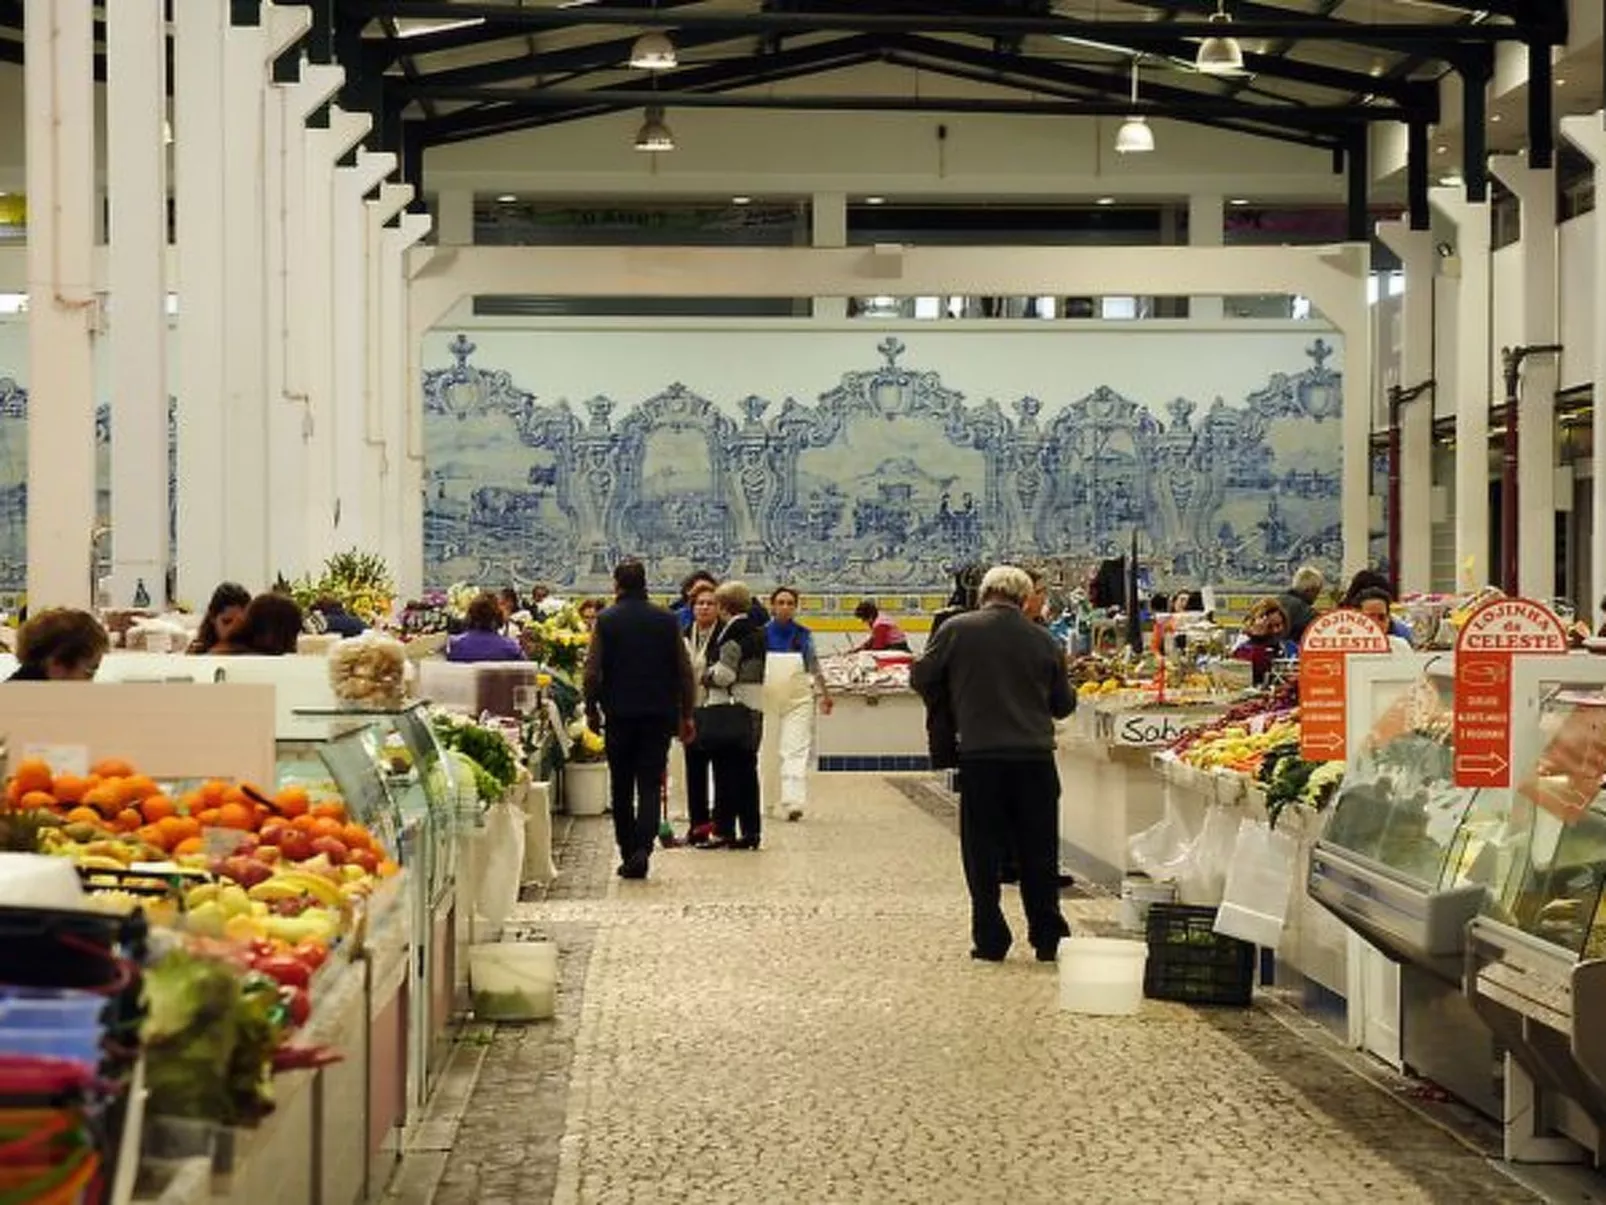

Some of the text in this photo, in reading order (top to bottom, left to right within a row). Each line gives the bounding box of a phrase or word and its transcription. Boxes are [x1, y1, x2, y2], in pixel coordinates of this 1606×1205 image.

[1314, 612, 1374, 634] LOJINHA
[1473, 604, 1549, 631] LOJINHA
[1308, 637, 1383, 649] CELESTE
[1467, 634, 1560, 648] CELESTE
